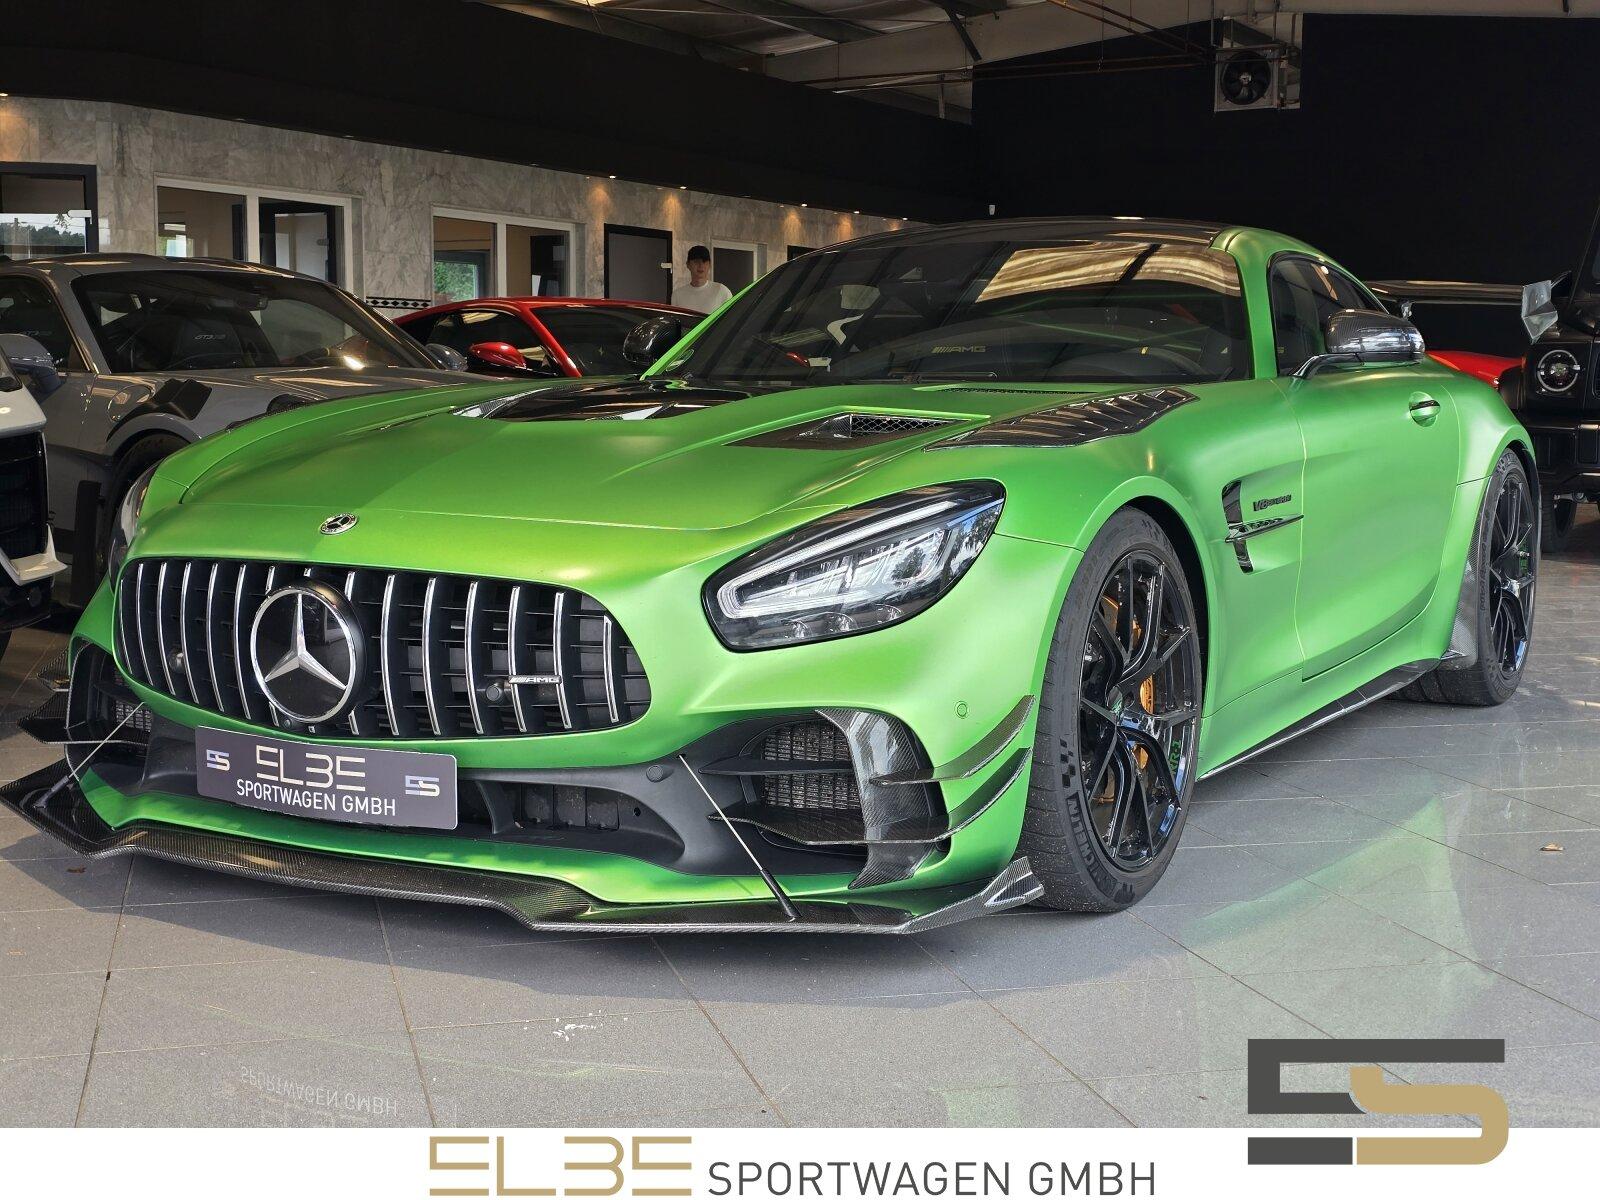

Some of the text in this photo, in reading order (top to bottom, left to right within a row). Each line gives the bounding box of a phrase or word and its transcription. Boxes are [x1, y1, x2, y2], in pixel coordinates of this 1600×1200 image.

[949, 345, 987, 353] AMG
[524, 676, 560, 684] AMG
[255, 744, 367, 793] ELBE
[236, 778, 397, 817] SPORTWAGEN GMBH
